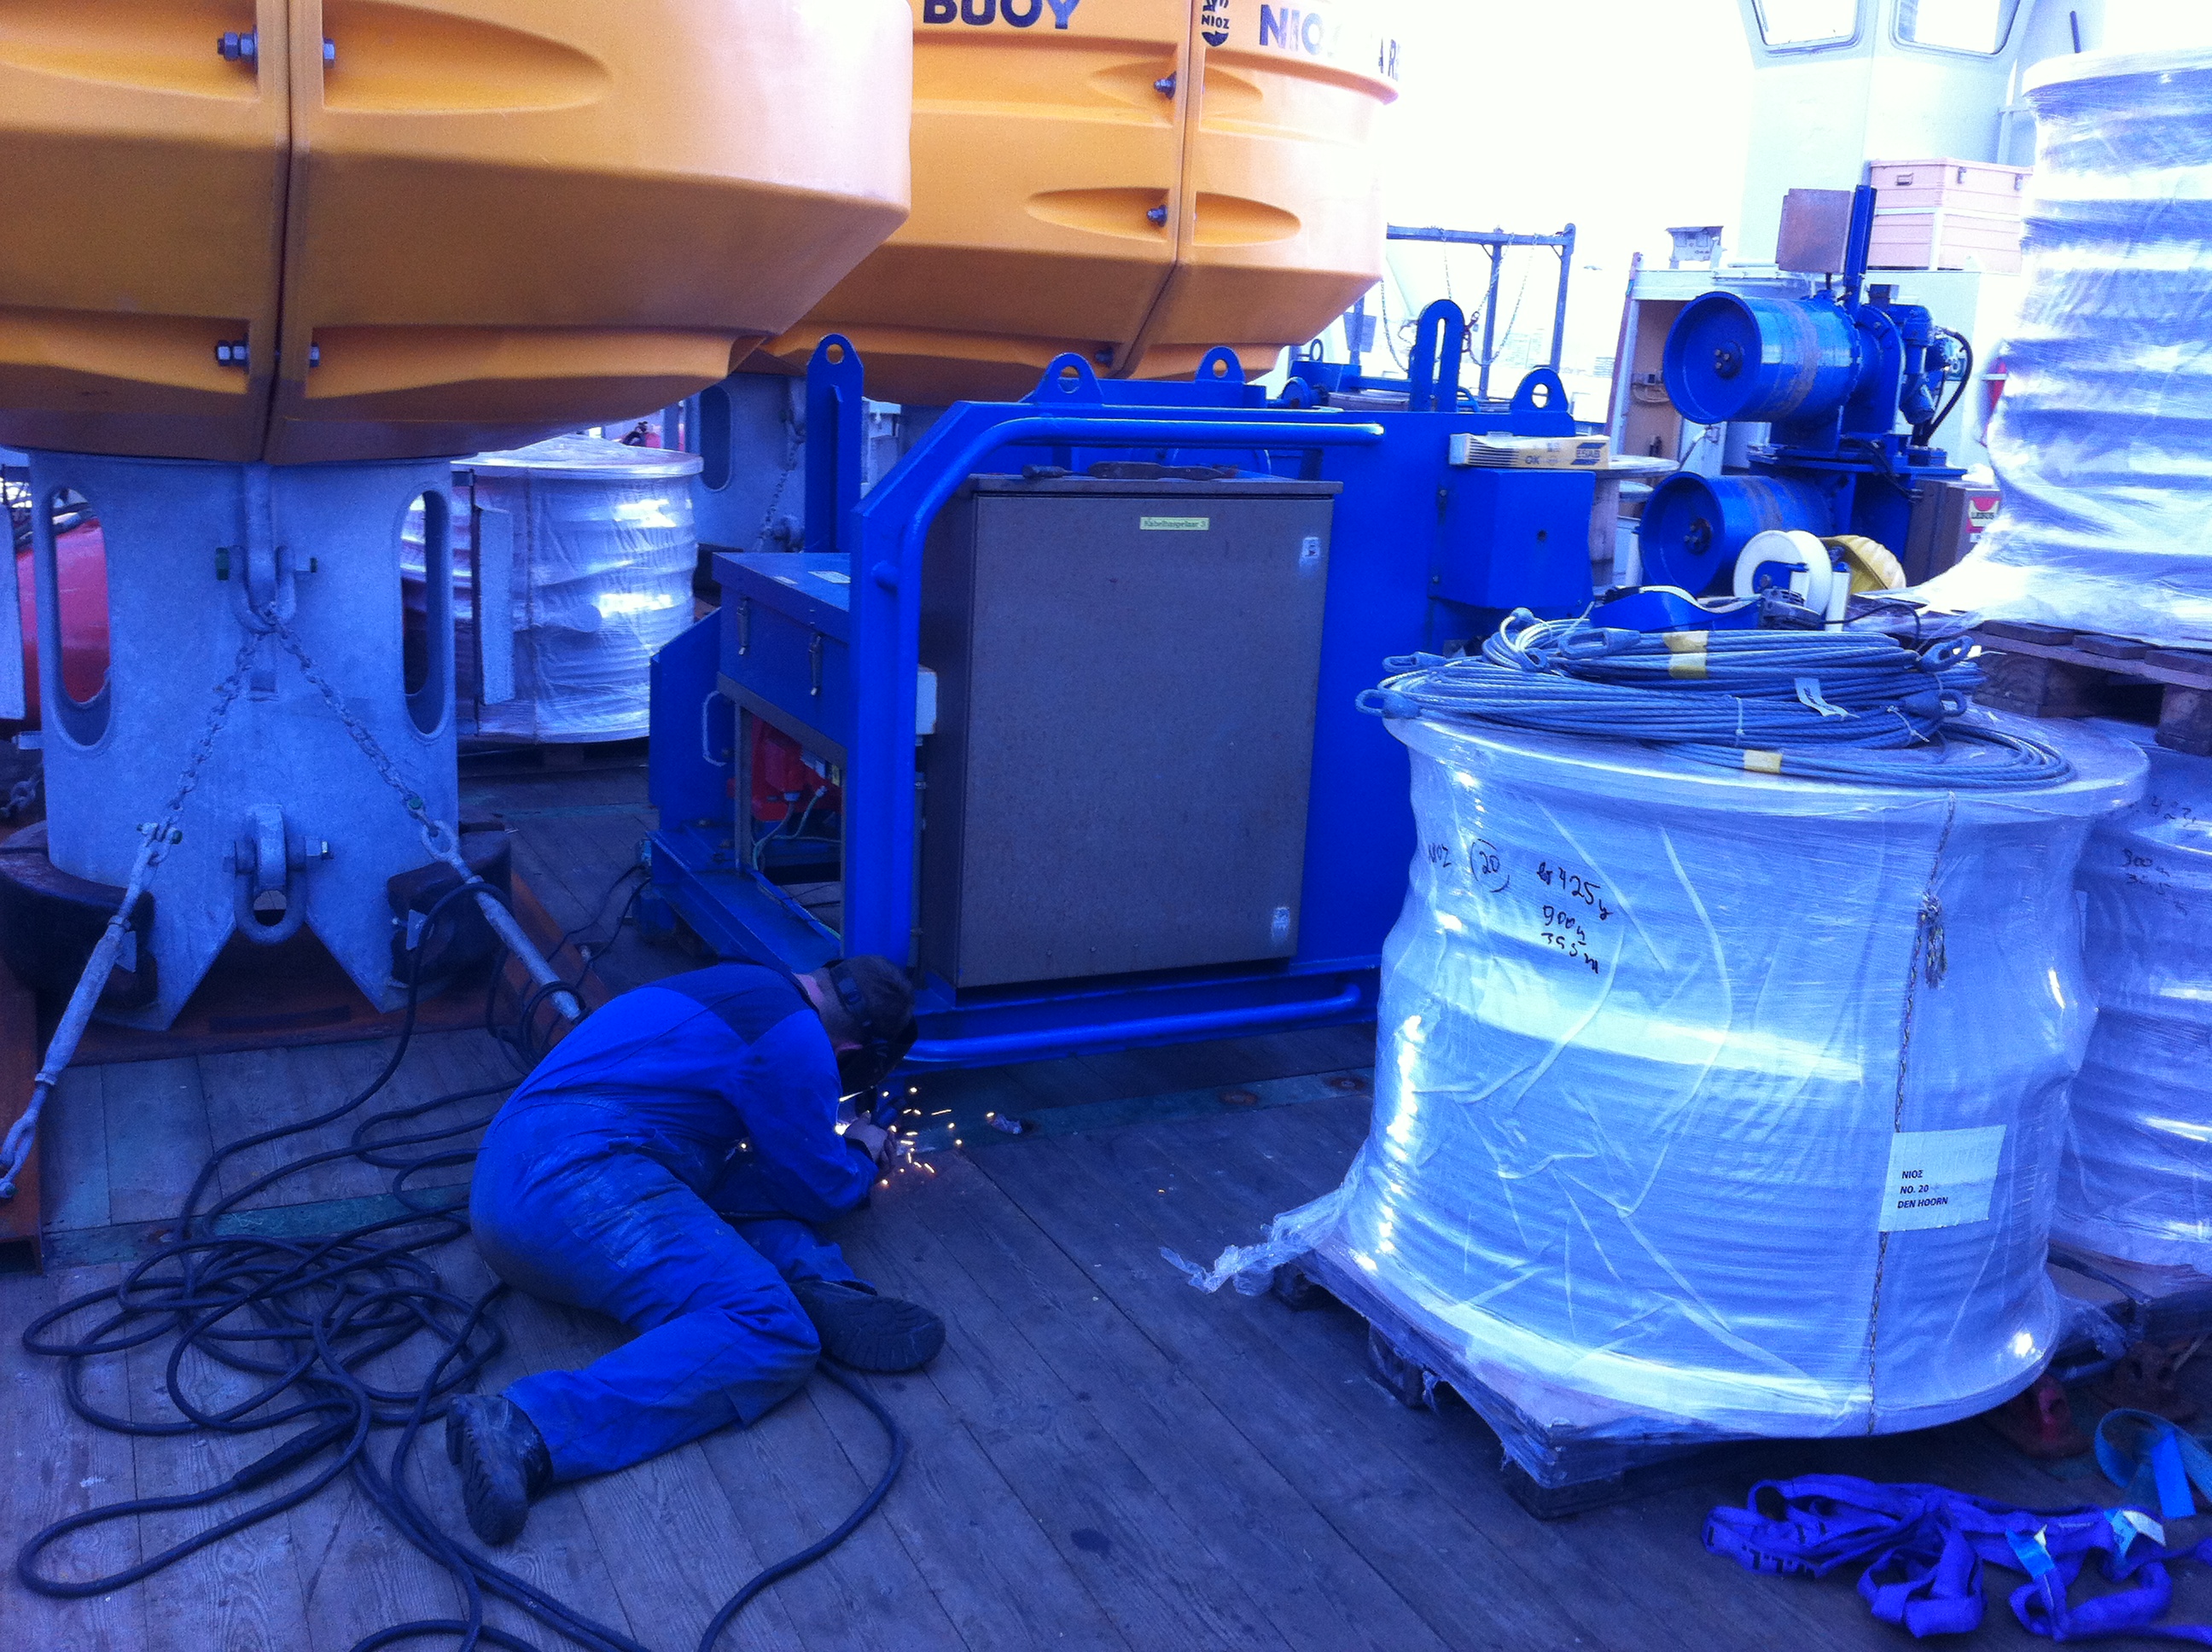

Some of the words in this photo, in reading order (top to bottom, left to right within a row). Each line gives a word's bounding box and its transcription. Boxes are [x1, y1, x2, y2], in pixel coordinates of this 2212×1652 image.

[923, 0, 1080, 29] BUOY
[1202, 14, 1230, 29] NIOZ
[1901, 1169, 1924, 1179] NIOZ
[1900, 1185, 1916, 1194] NO.
[1918, 1184, 1930, 1193] 20
[1897, 1200, 1916, 1208] DEN
[1917, 1196, 1948, 1207] HOORN
